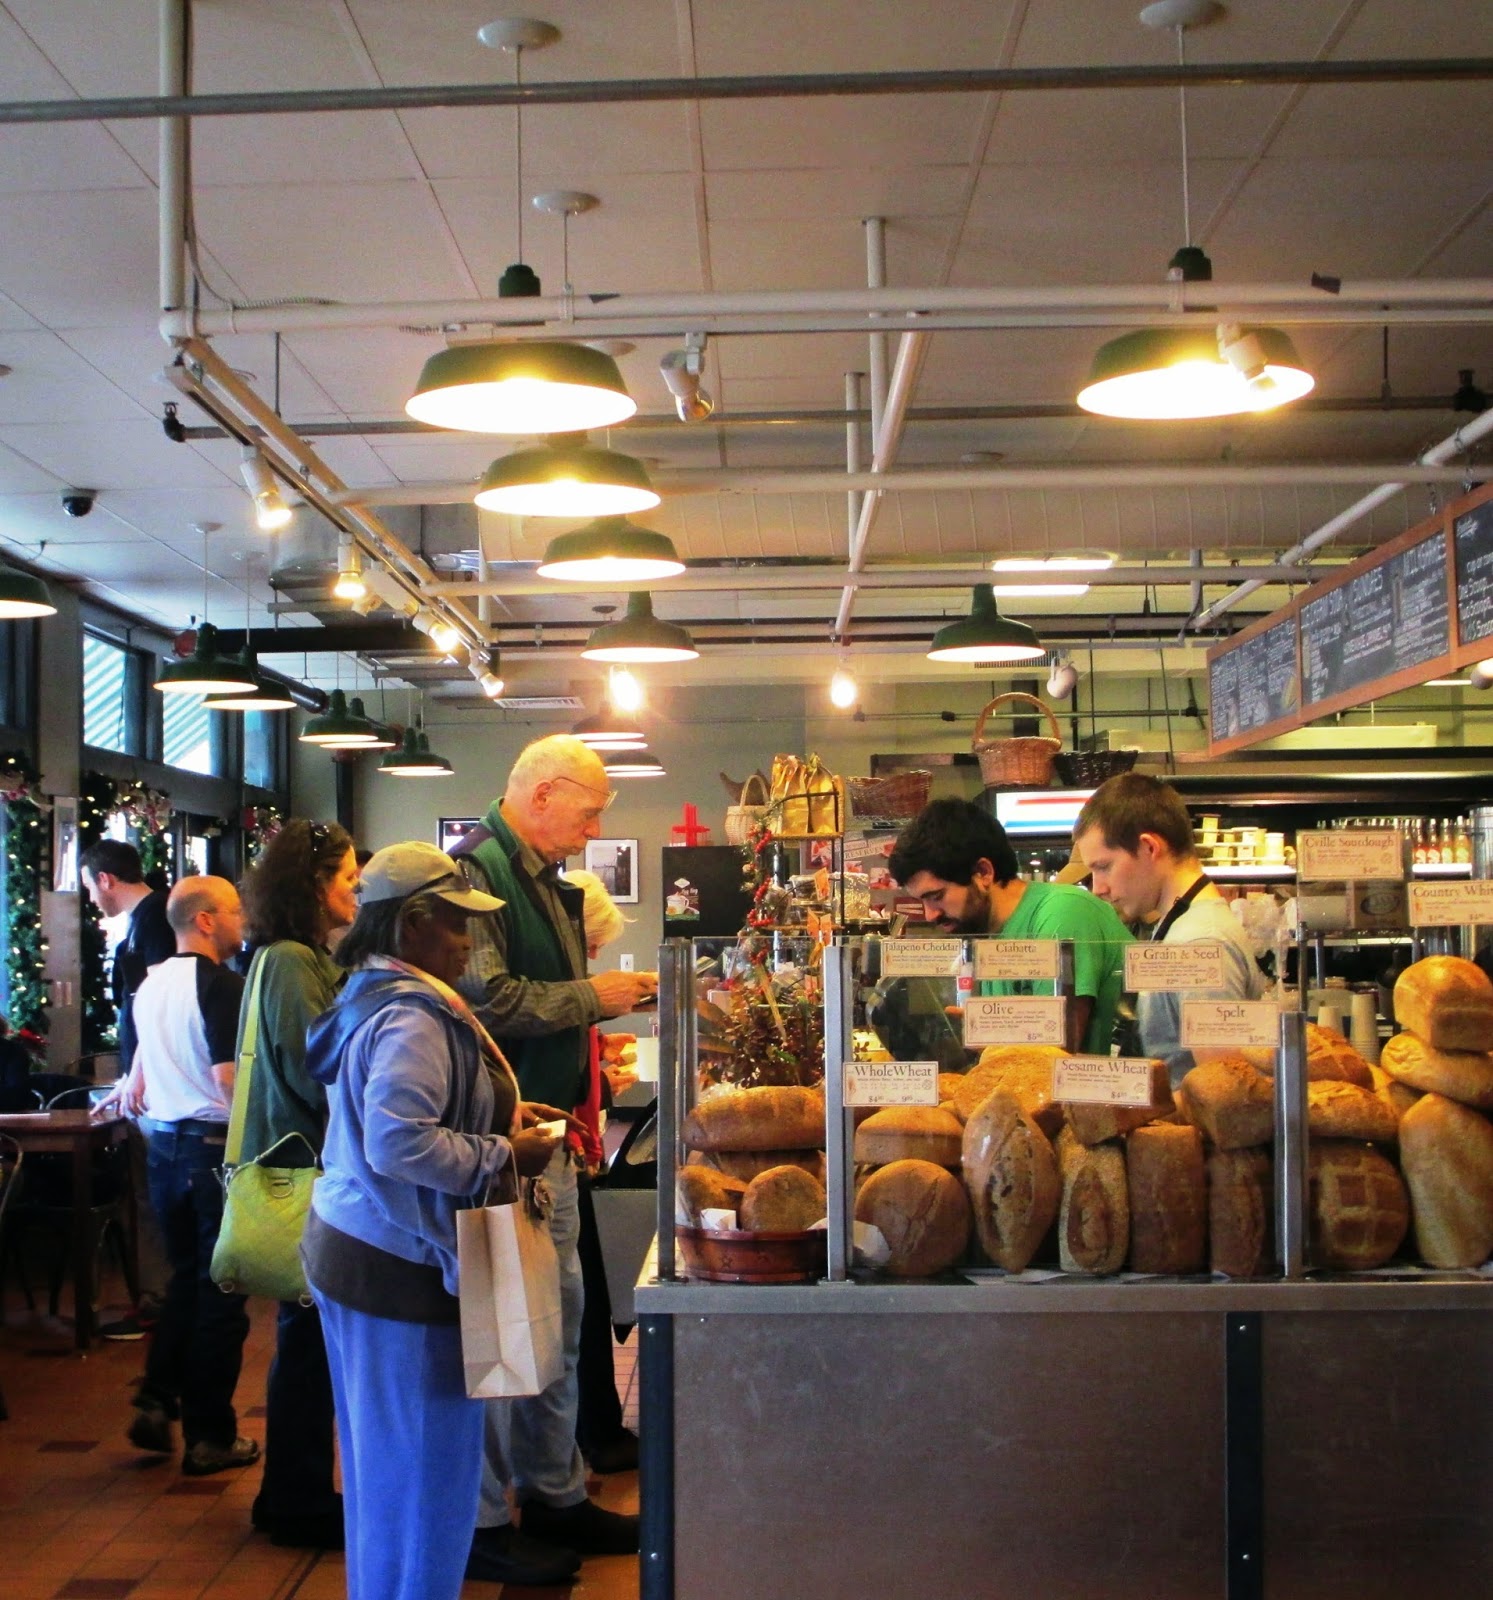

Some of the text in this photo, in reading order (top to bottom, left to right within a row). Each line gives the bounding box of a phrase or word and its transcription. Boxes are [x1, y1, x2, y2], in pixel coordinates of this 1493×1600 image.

[1306, 836, 1394, 850] Cville Sourdough
[1413, 886, 1459, 898] Country
[923, 942, 959, 952] Cheddar
[996, 942, 1037, 953] Ciabatta
[1143, 947, 1177, 960] Grain
[1180, 949, 1190, 960] &
[1193, 947, 1220, 960] Seed
[982, 1002, 1014, 1015] Olive
[1216, 1005, 1246, 1021] Spelt
[1062, 1059, 1147, 1075] Sesame Wheat
